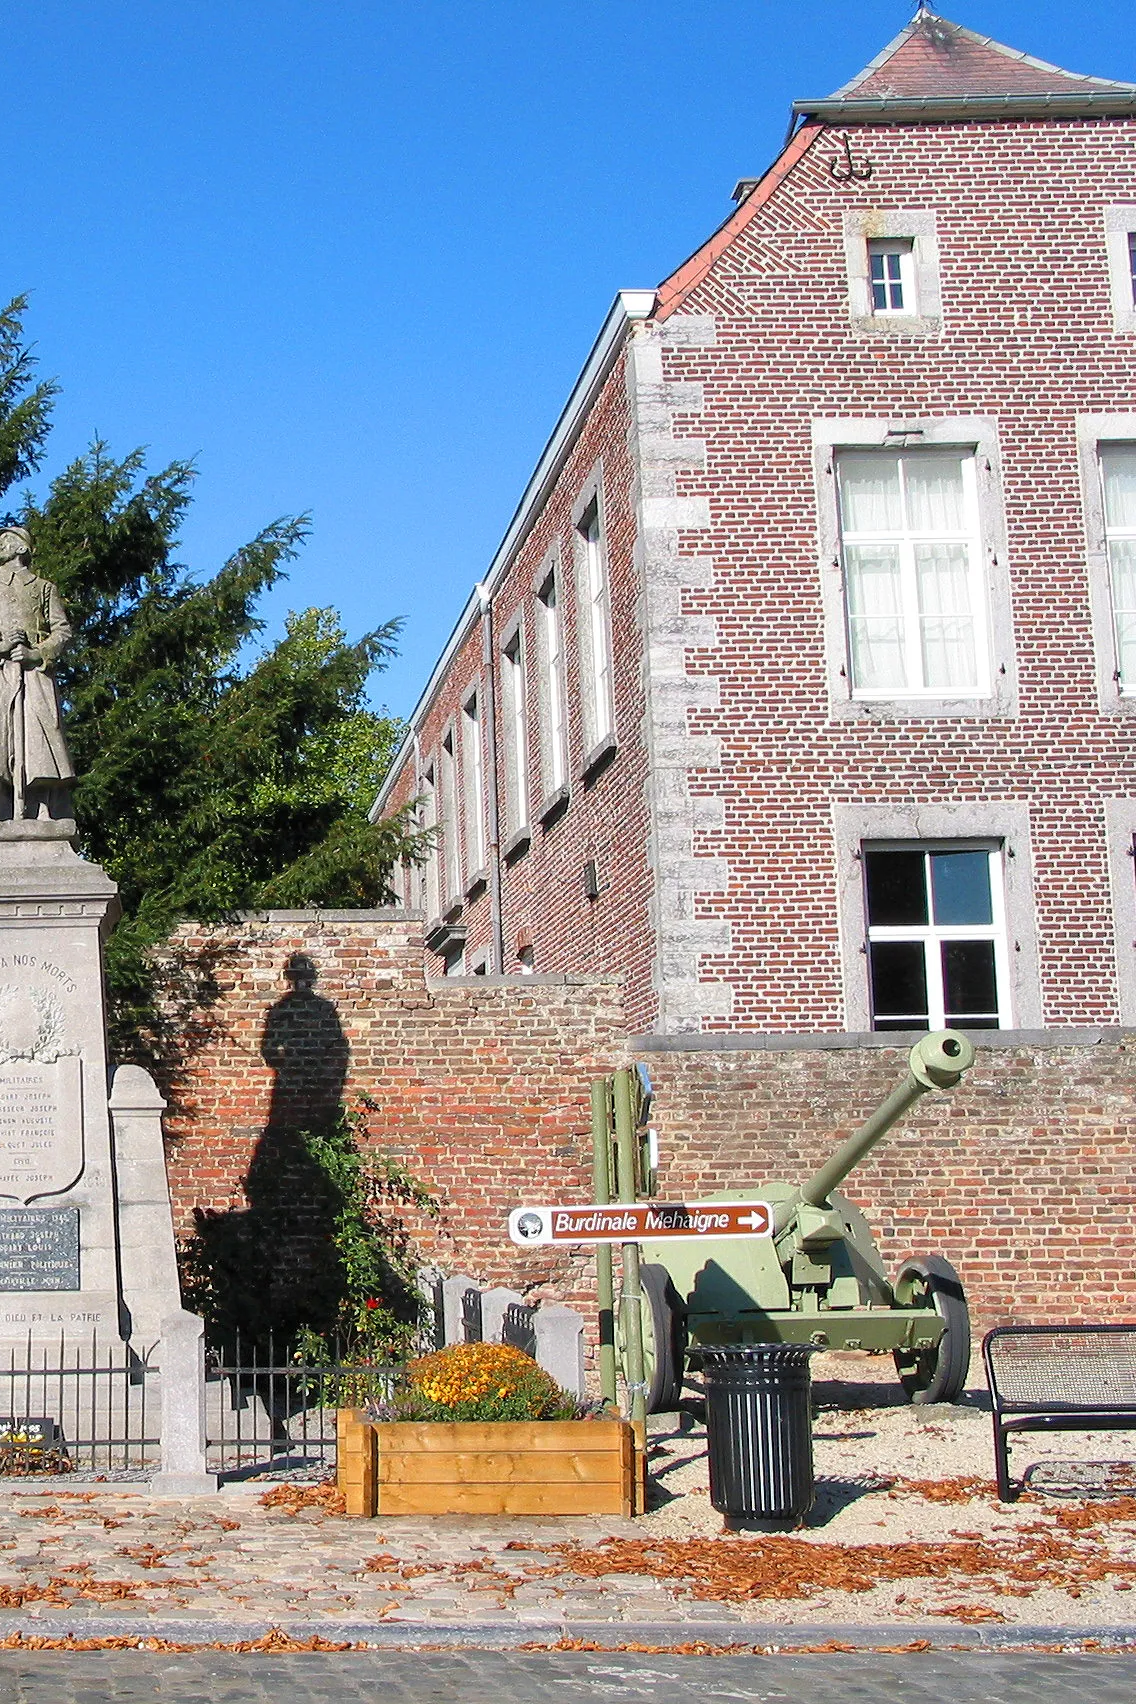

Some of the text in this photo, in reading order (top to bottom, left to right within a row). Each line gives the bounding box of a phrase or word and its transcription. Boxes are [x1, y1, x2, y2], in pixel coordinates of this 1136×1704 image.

[1, 957, 8, 968] A
[13, 954, 37, 966] NOS
[41, 961, 77, 993] MORTS
[554, 1209, 730, 1234] Burdinale Mehaigne
[50, 1313, 63, 1322] LA
[70, 1312, 101, 1322] PATRIE
